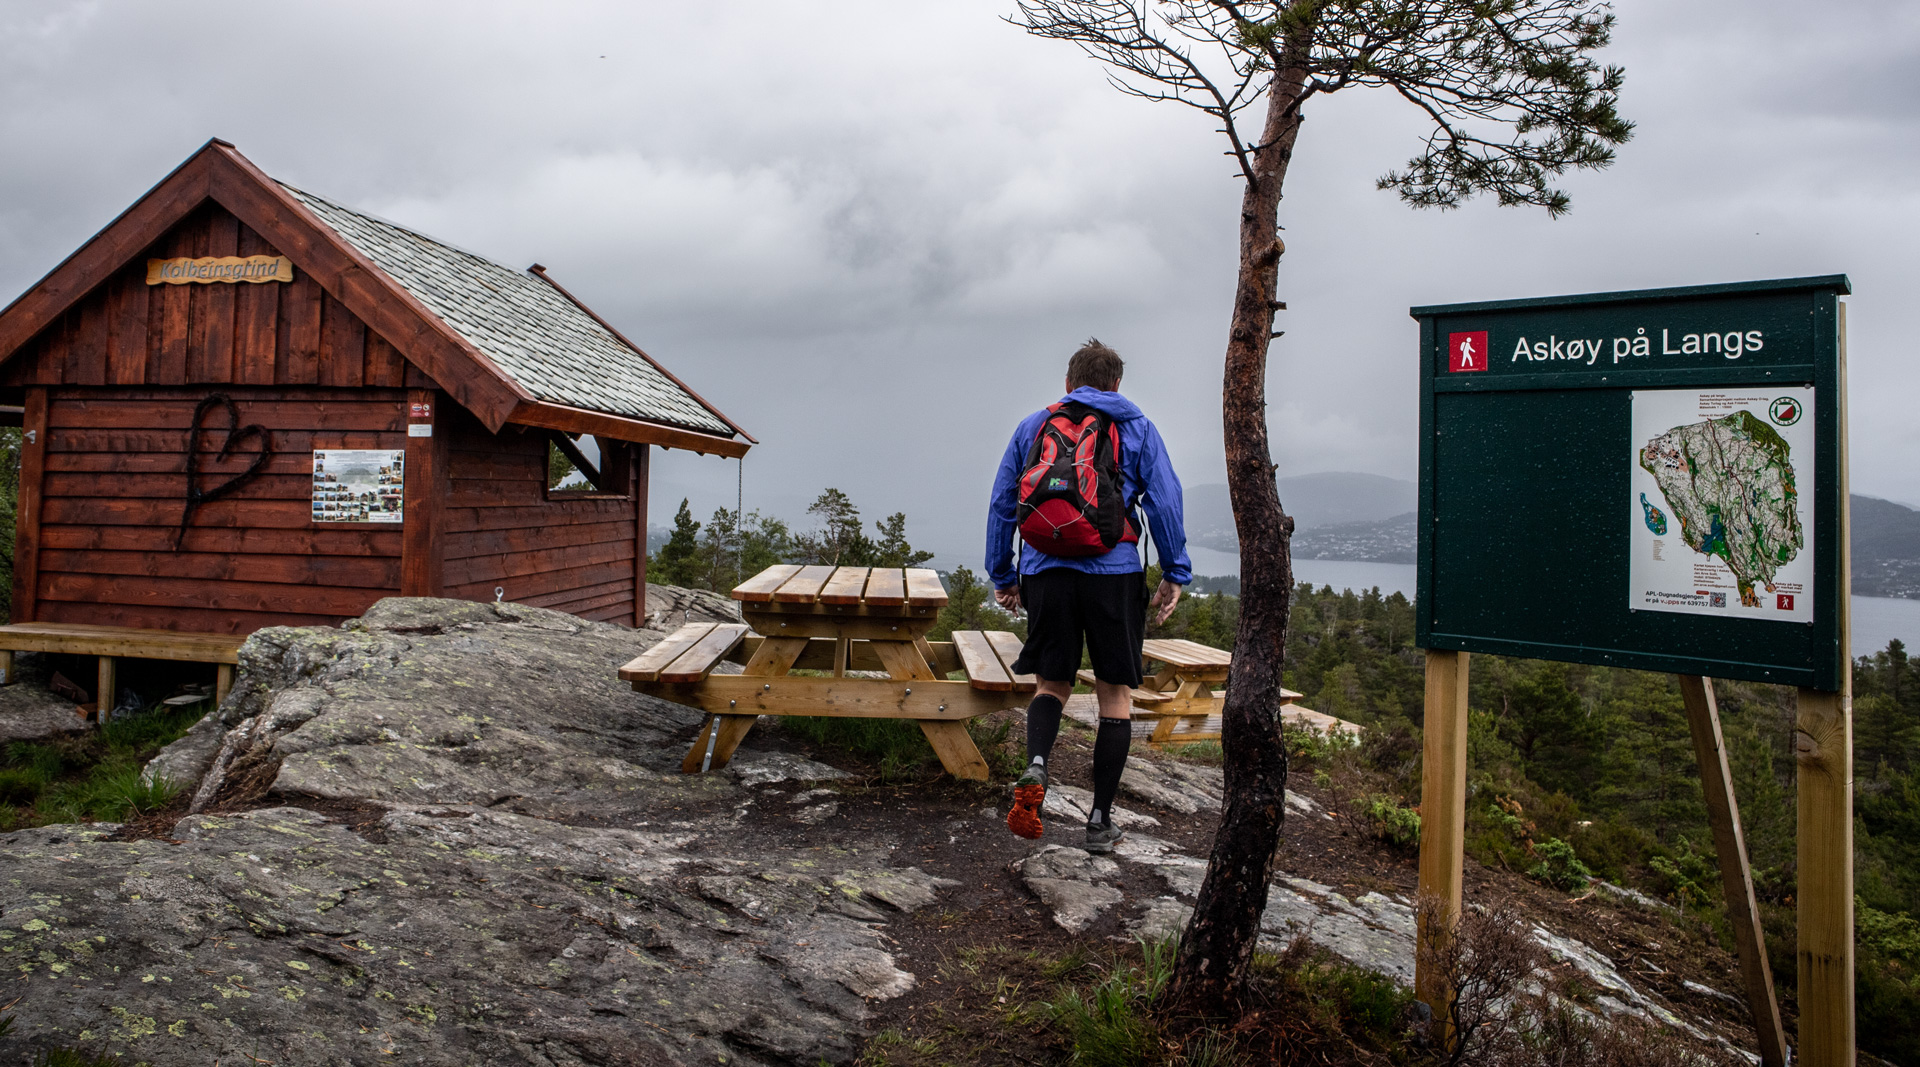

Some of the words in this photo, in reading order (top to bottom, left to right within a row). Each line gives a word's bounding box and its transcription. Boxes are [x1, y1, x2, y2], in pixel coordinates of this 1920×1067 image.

[160, 259, 279, 279] Kolbeinsgrind
[1511, 335, 1603, 366] Askøy
[1612, 327, 1650, 364] på
[1662, 328, 1764, 360] Langs
[1645, 590, 1705, 600] APL-Dugnadsgjengen
